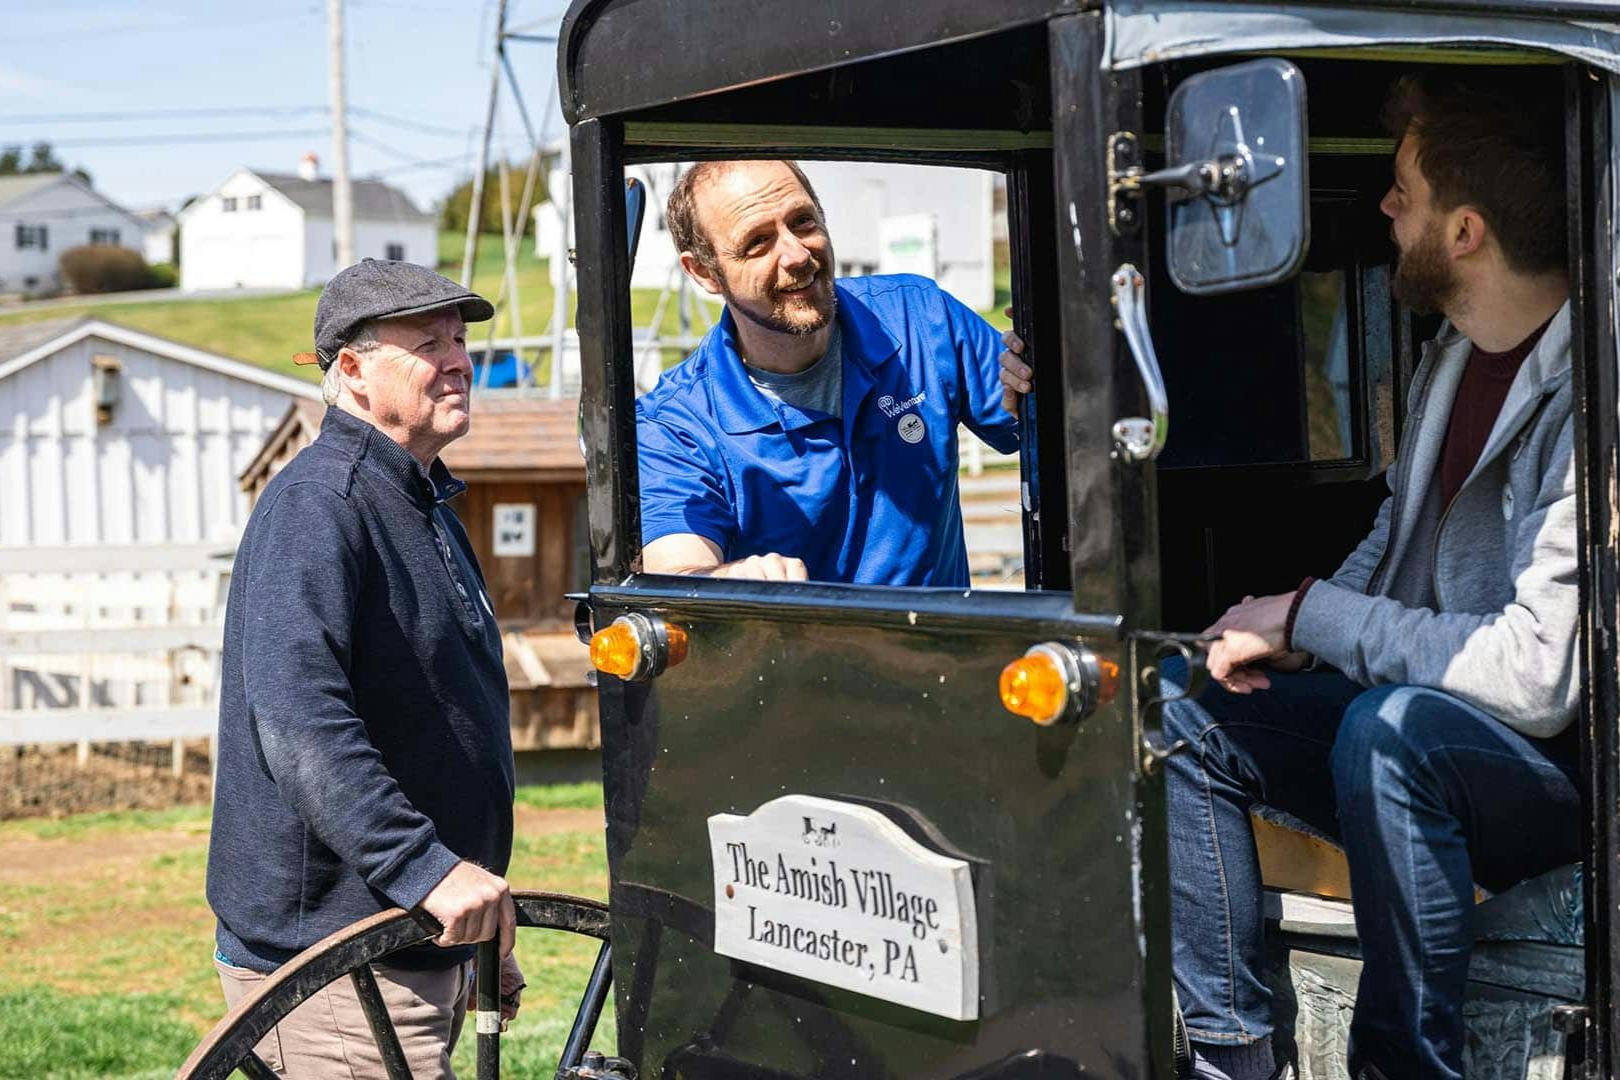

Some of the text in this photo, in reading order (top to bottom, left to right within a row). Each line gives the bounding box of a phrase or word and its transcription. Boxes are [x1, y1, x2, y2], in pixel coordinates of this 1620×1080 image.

[727, 842, 939, 940] The Amish Village
[747, 905, 919, 982] Lancaster, PA
